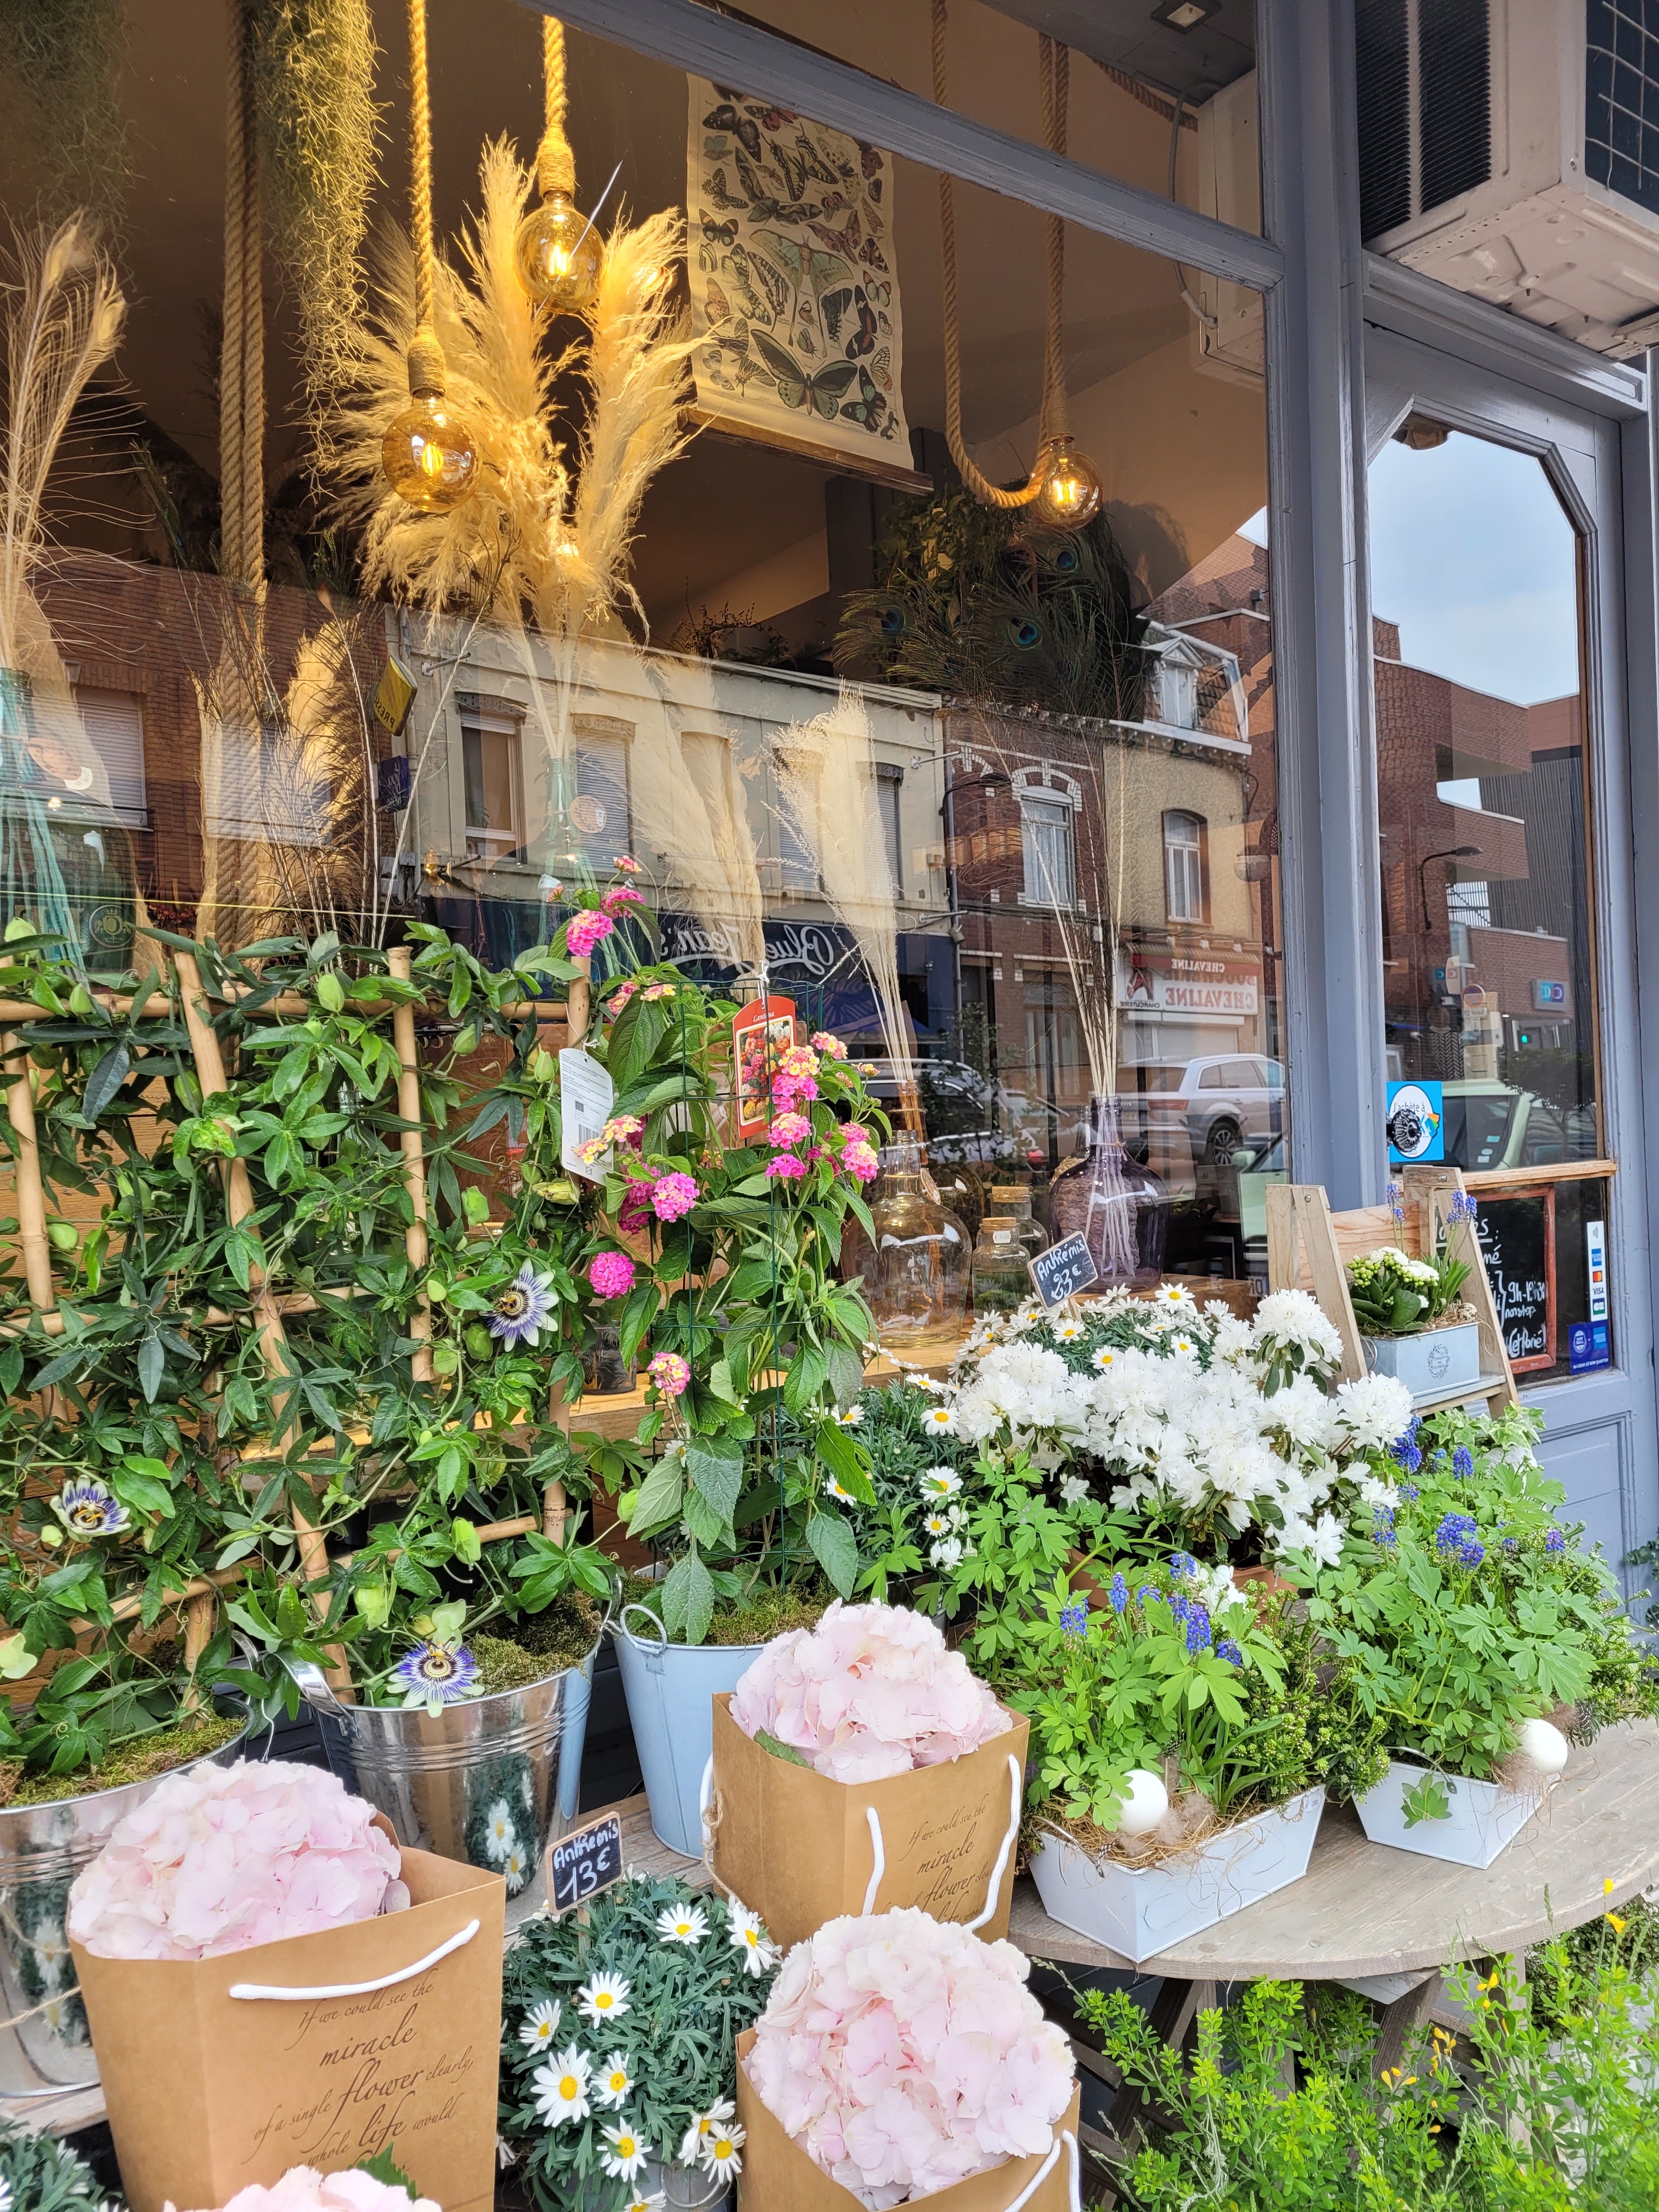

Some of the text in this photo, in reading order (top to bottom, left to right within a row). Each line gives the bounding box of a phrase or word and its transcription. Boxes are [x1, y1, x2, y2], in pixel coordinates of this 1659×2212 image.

[1593, 1287, 1604, 1295] VISA
[898, 1793, 989, 1861] If we could see the
[917, 1821, 977, 1875] miracle
[922, 1865, 975, 1913] flower
[284, 1968, 438, 2051] If we could see the
[320, 2002, 418, 2068] miracle
[241, 2045, 473, 2164] of a single flower clearly,
[308, 2130, 351, 2166] whole
[358, 2091, 415, 2155] life
[413, 2092, 465, 2130] would
